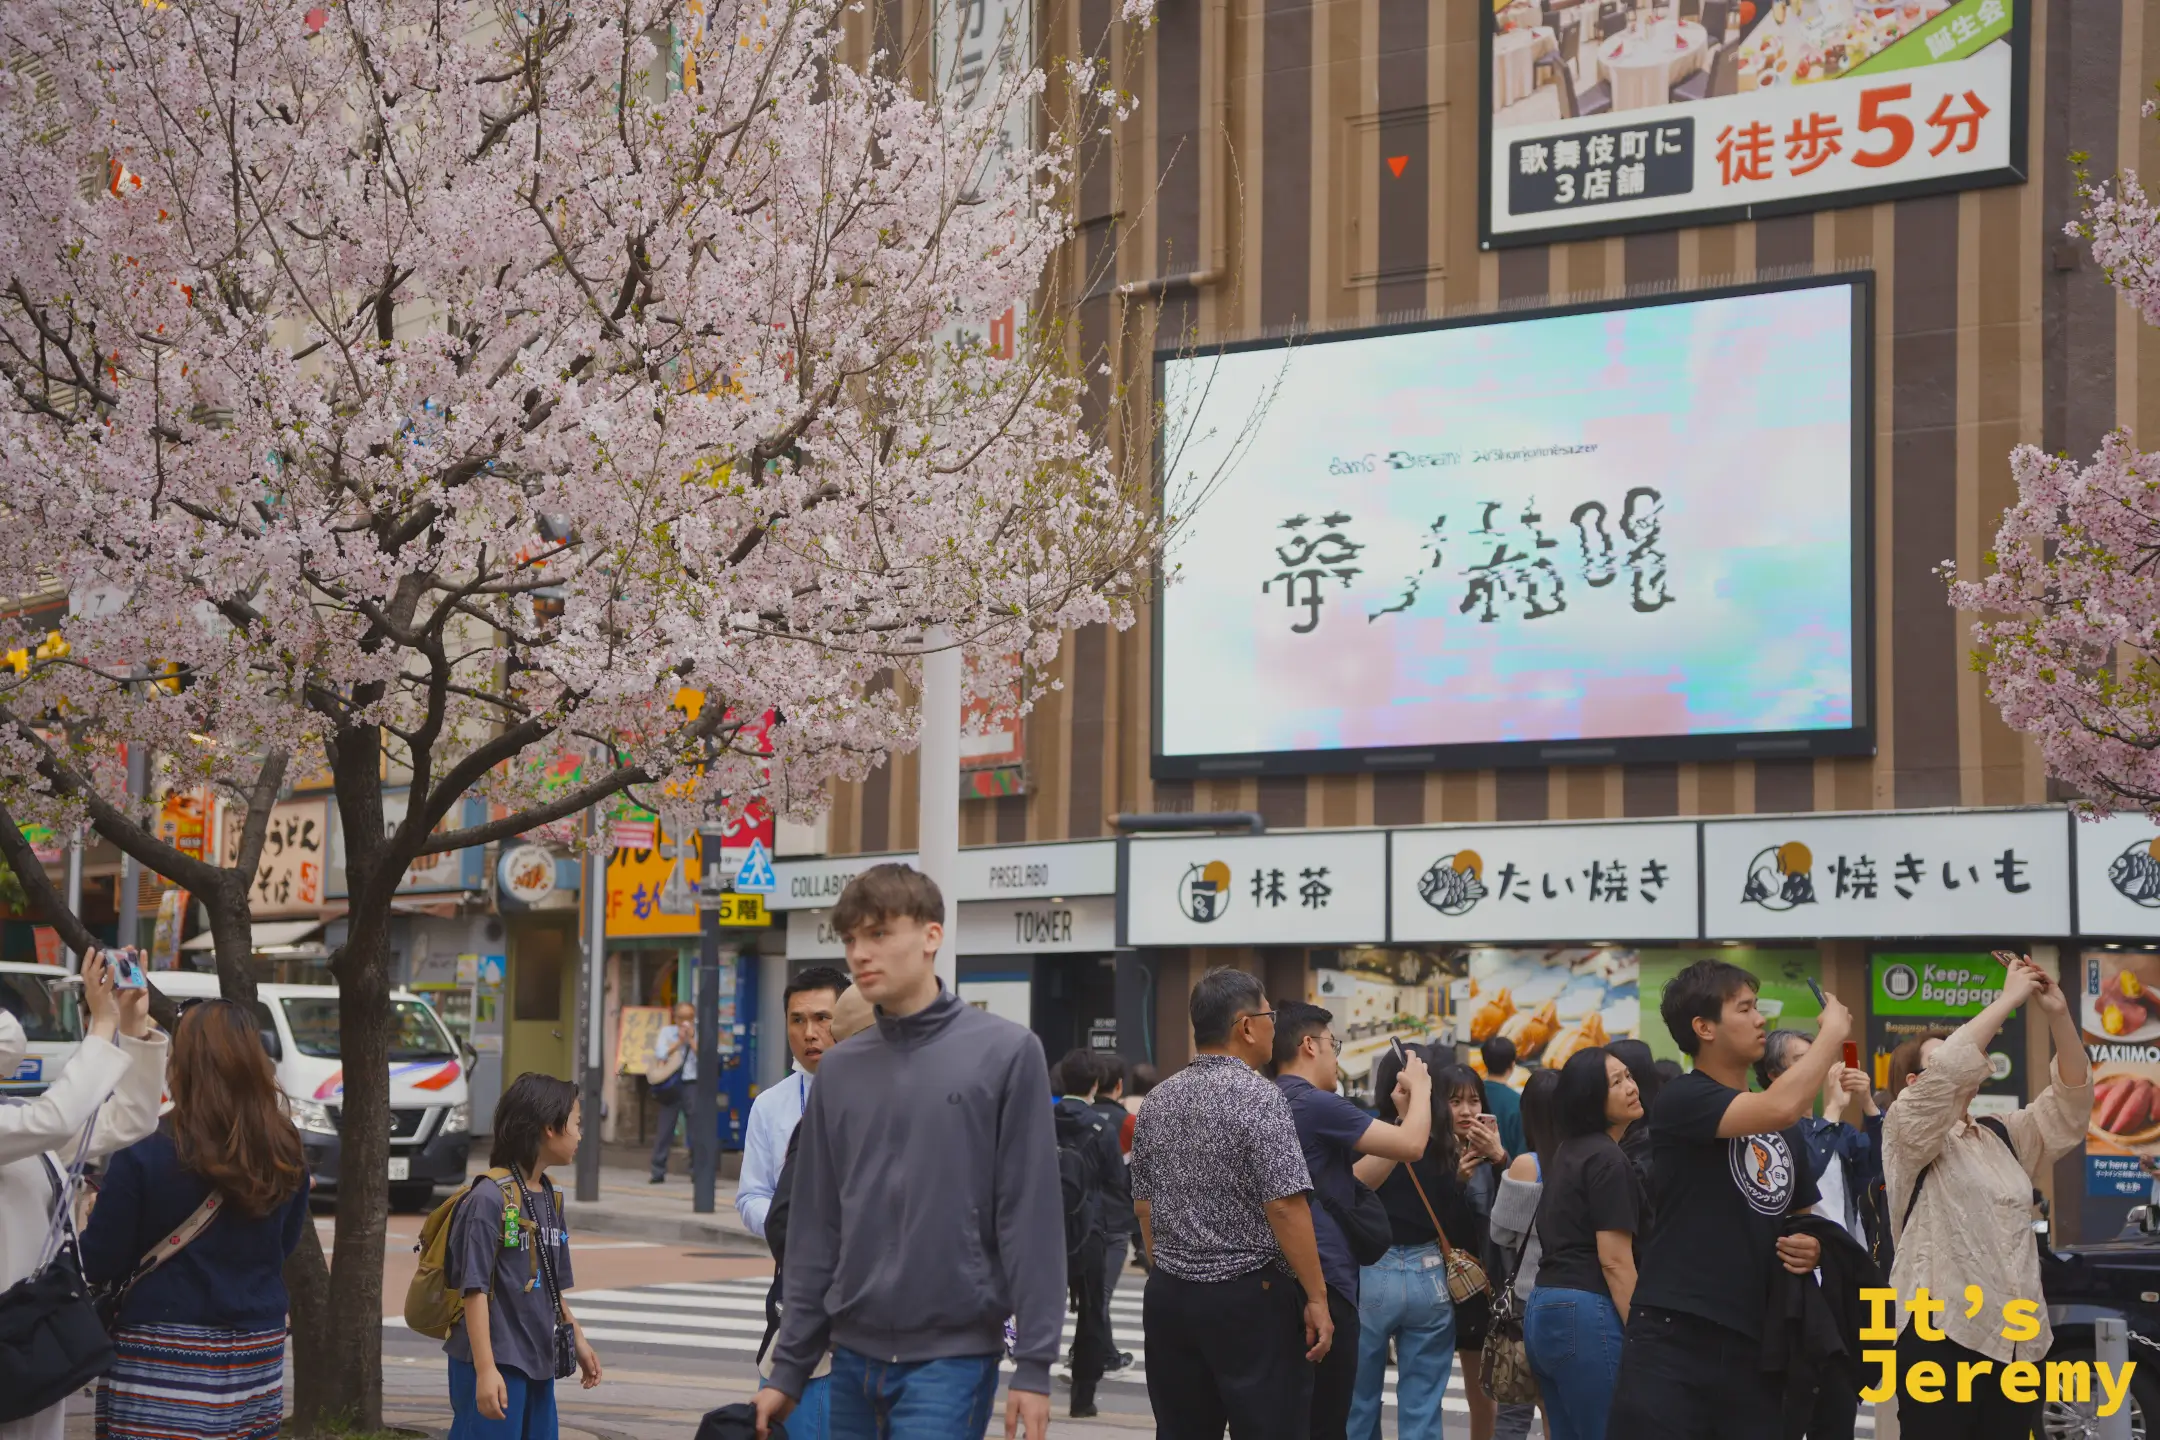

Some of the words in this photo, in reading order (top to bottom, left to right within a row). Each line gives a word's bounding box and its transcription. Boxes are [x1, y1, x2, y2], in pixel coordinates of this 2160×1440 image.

[1519, 127, 1682, 175] 歌舞伎町に
[1716, 83, 1991, 187] 徒歩5分
[1554, 162, 1645, 204] 3店舗
[1251, 867, 1333, 909] 抹茶
[1498, 858, 1670, 904] たい焼き
[1828, 849, 2032, 899] 焼きいも
[1014, 910, 1072, 944] TOWER
[1923, 964, 1970, 986] Keep
[1972, 974, 1986, 985] my
[2088, 1045, 2160, 1063] YAKIIMO
[2095, 1159, 2108, 1170] For
[2109, 1159, 2129, 1170] here
[1430, 1273, 1450, 1303] LA
